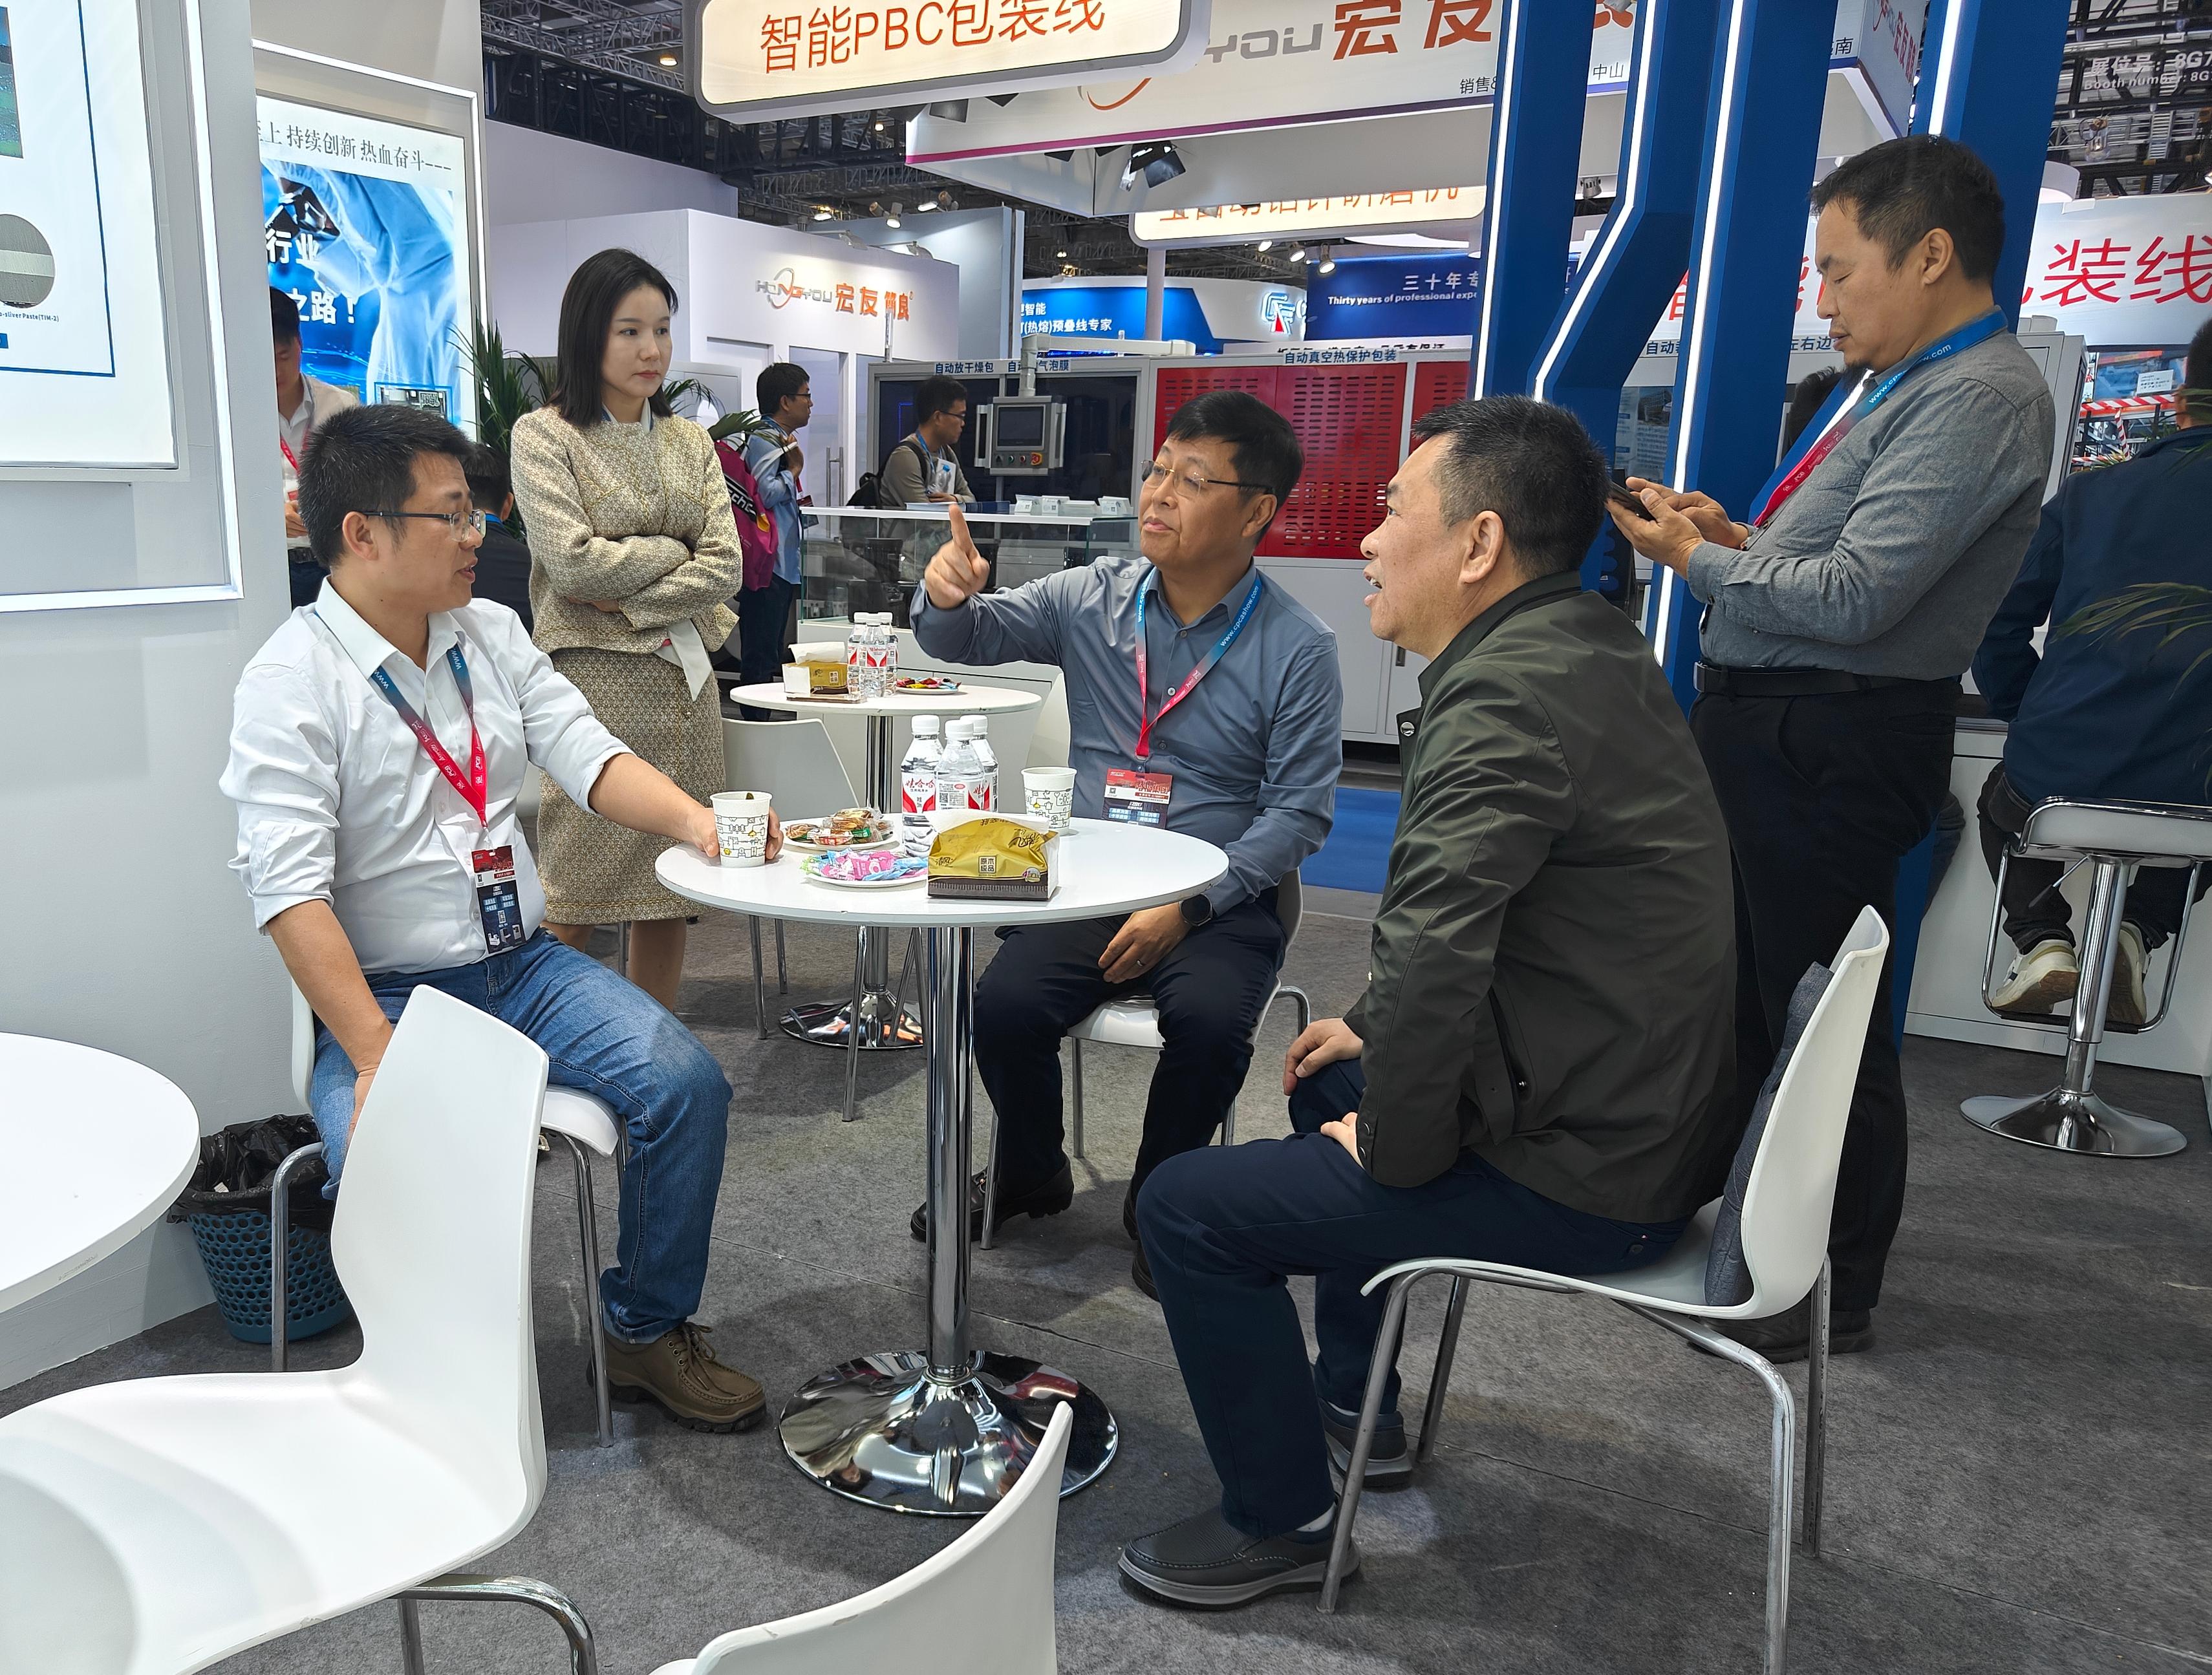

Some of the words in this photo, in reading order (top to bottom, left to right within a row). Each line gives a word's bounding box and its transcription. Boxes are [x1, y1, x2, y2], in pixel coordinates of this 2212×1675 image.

[761, 0, 1105, 73] 智能PBC包装线
[1831, 37, 1854, 56] 南
[1593, 62, 1624, 80] 中山
[2084, 78, 2125, 90] Booth
[2190, 70, 2212, 81] 8G
[287, 125, 356, 159] 持续创新
[265, 228, 322, 264] 行业
[2022, 235, 2212, 306] 装线
[1328, 296, 1357, 306] Thirty
[1357, 296, 1382, 306] years
[1384, 293, 1394, 303] of
[1395, 292, 1454, 303] professional
[1285, 349, 1397, 364] 自动真空热保护包装
[935, 361, 994, 374] 自动放干燥包
[1220, 586, 1260, 646] www.cpcashow.com
